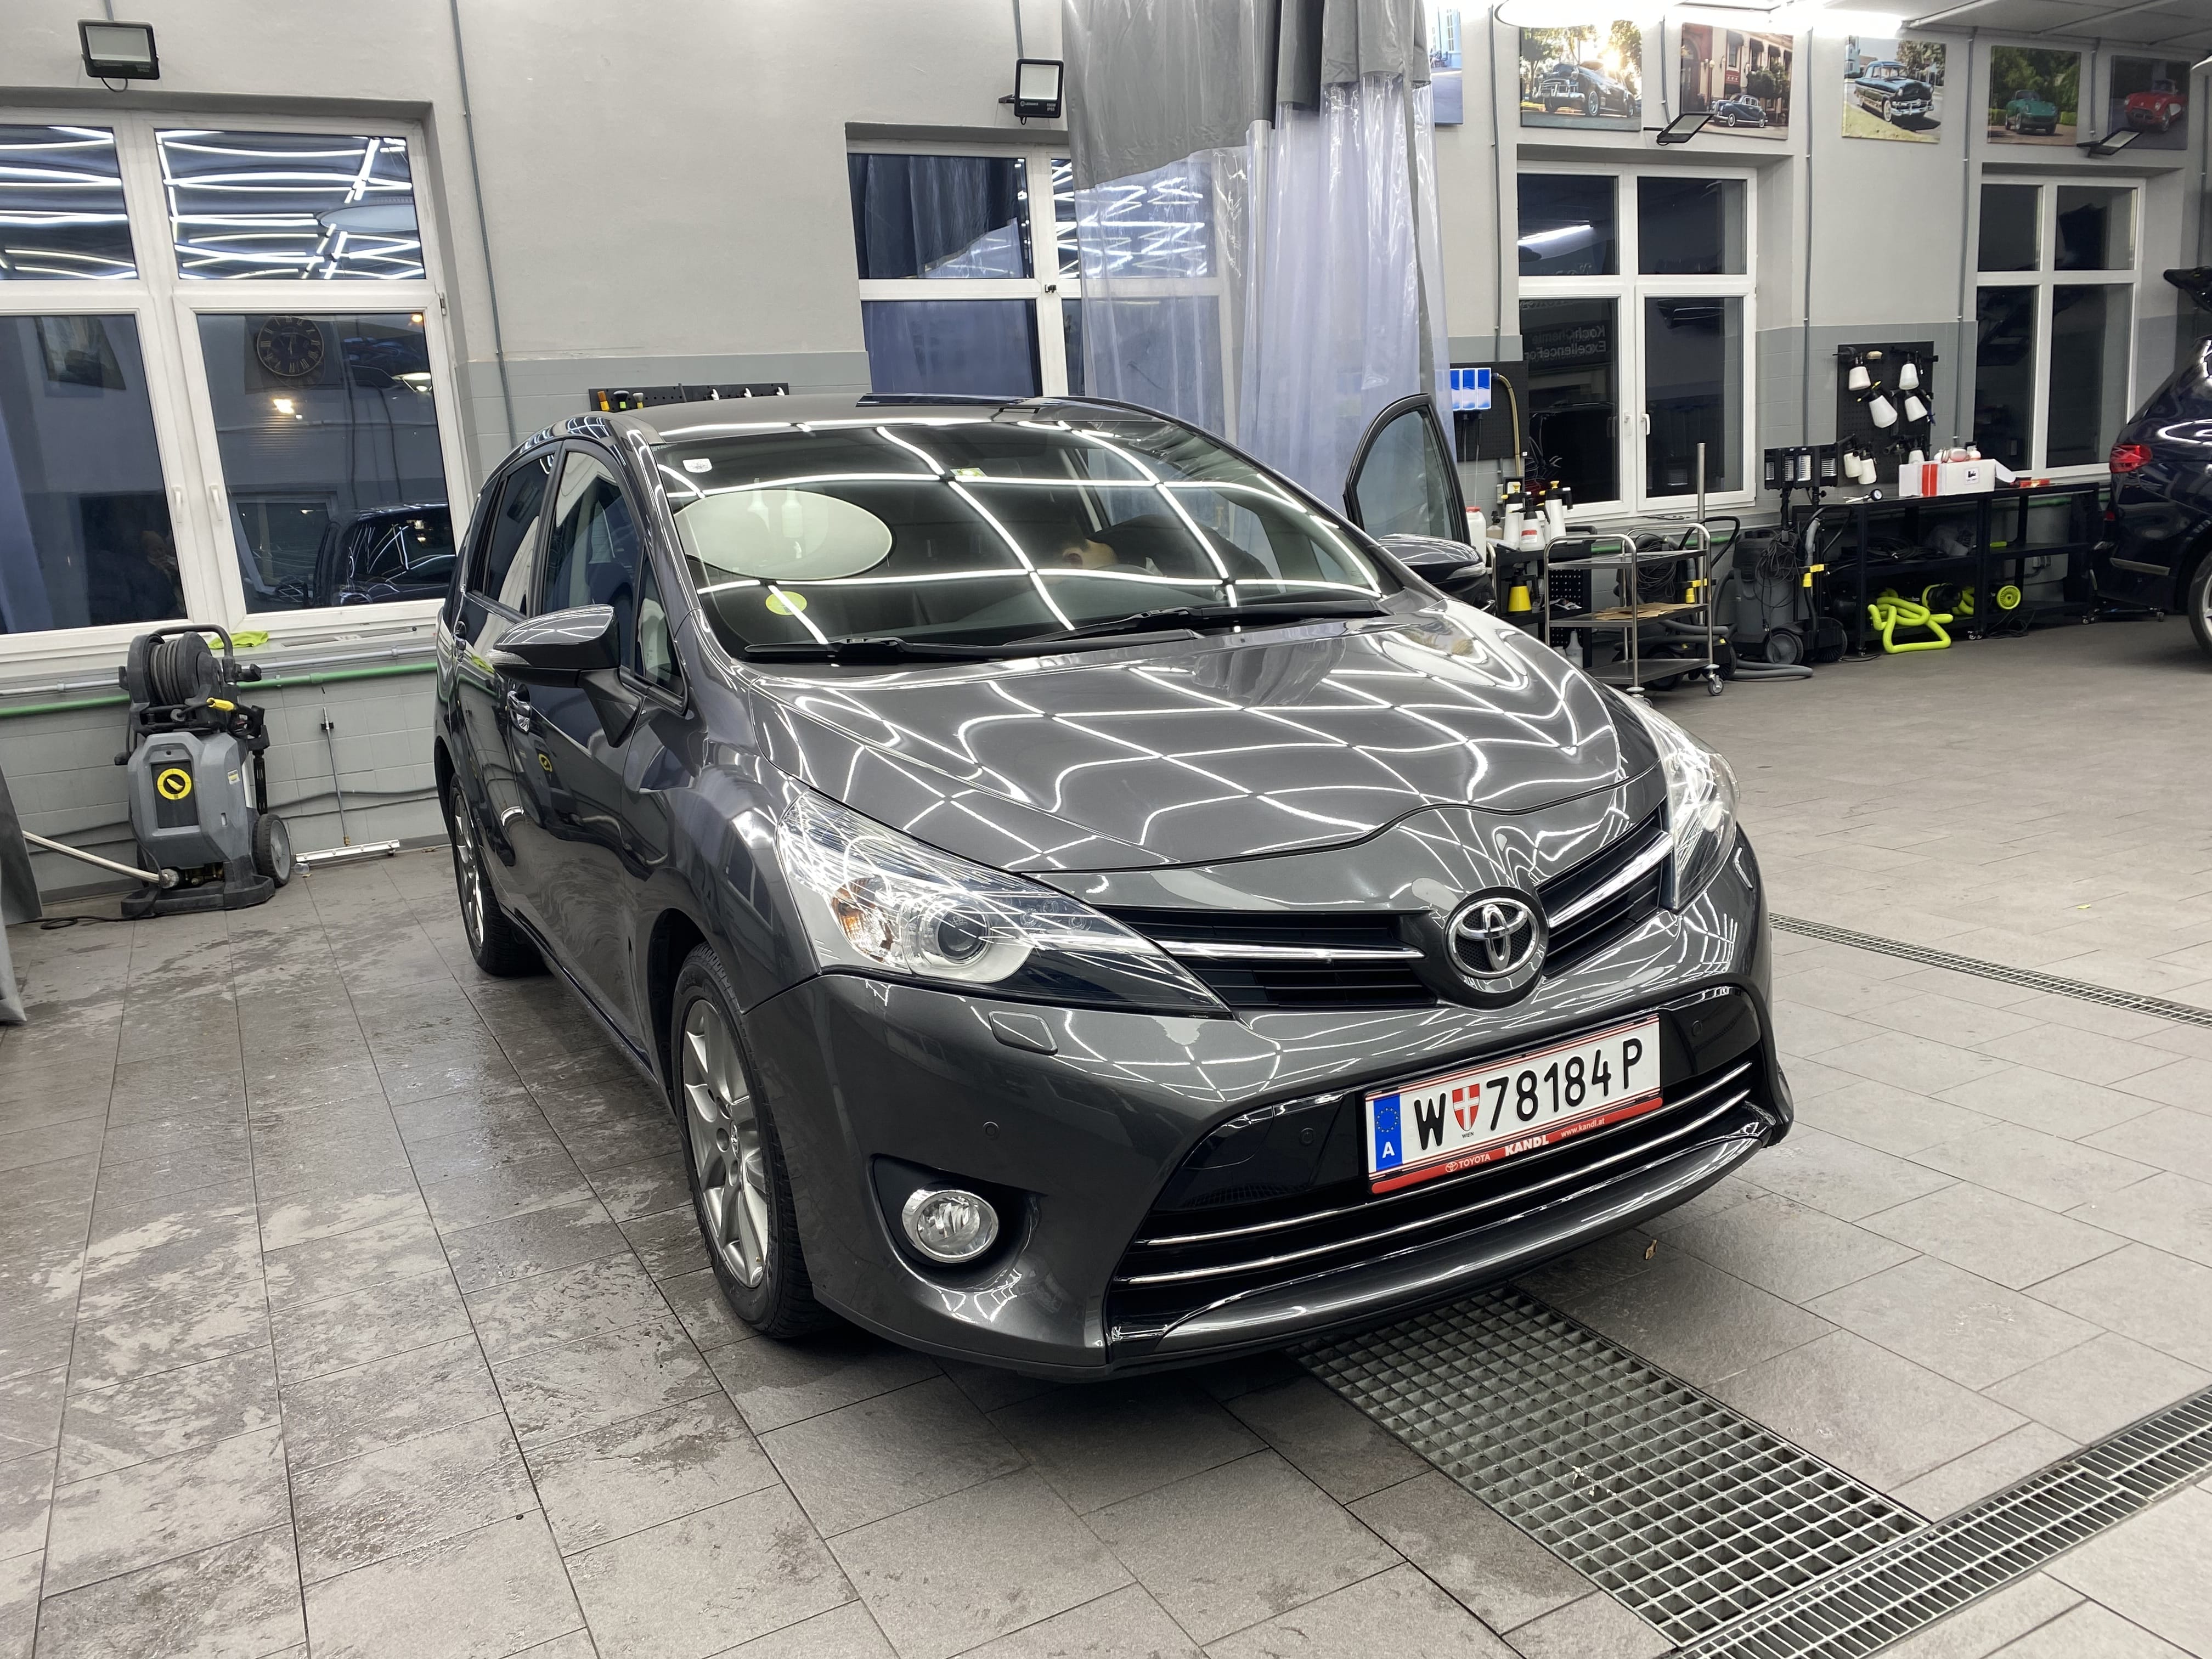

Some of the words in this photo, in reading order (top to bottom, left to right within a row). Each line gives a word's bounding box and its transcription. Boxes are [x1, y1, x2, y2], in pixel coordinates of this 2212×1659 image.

[1414, 1093, 1447, 1151] W
[1486, 1049, 1612, 1131] 78184
[1623, 1037, 1643, 1090] P
[1382, 1141, 1395, 1159] A
[1458, 1153, 1491, 1169] TOYOTA
[1505, 1135, 1549, 1156] KANDL
[1561, 1117, 1605, 1138] www.kandl.at
